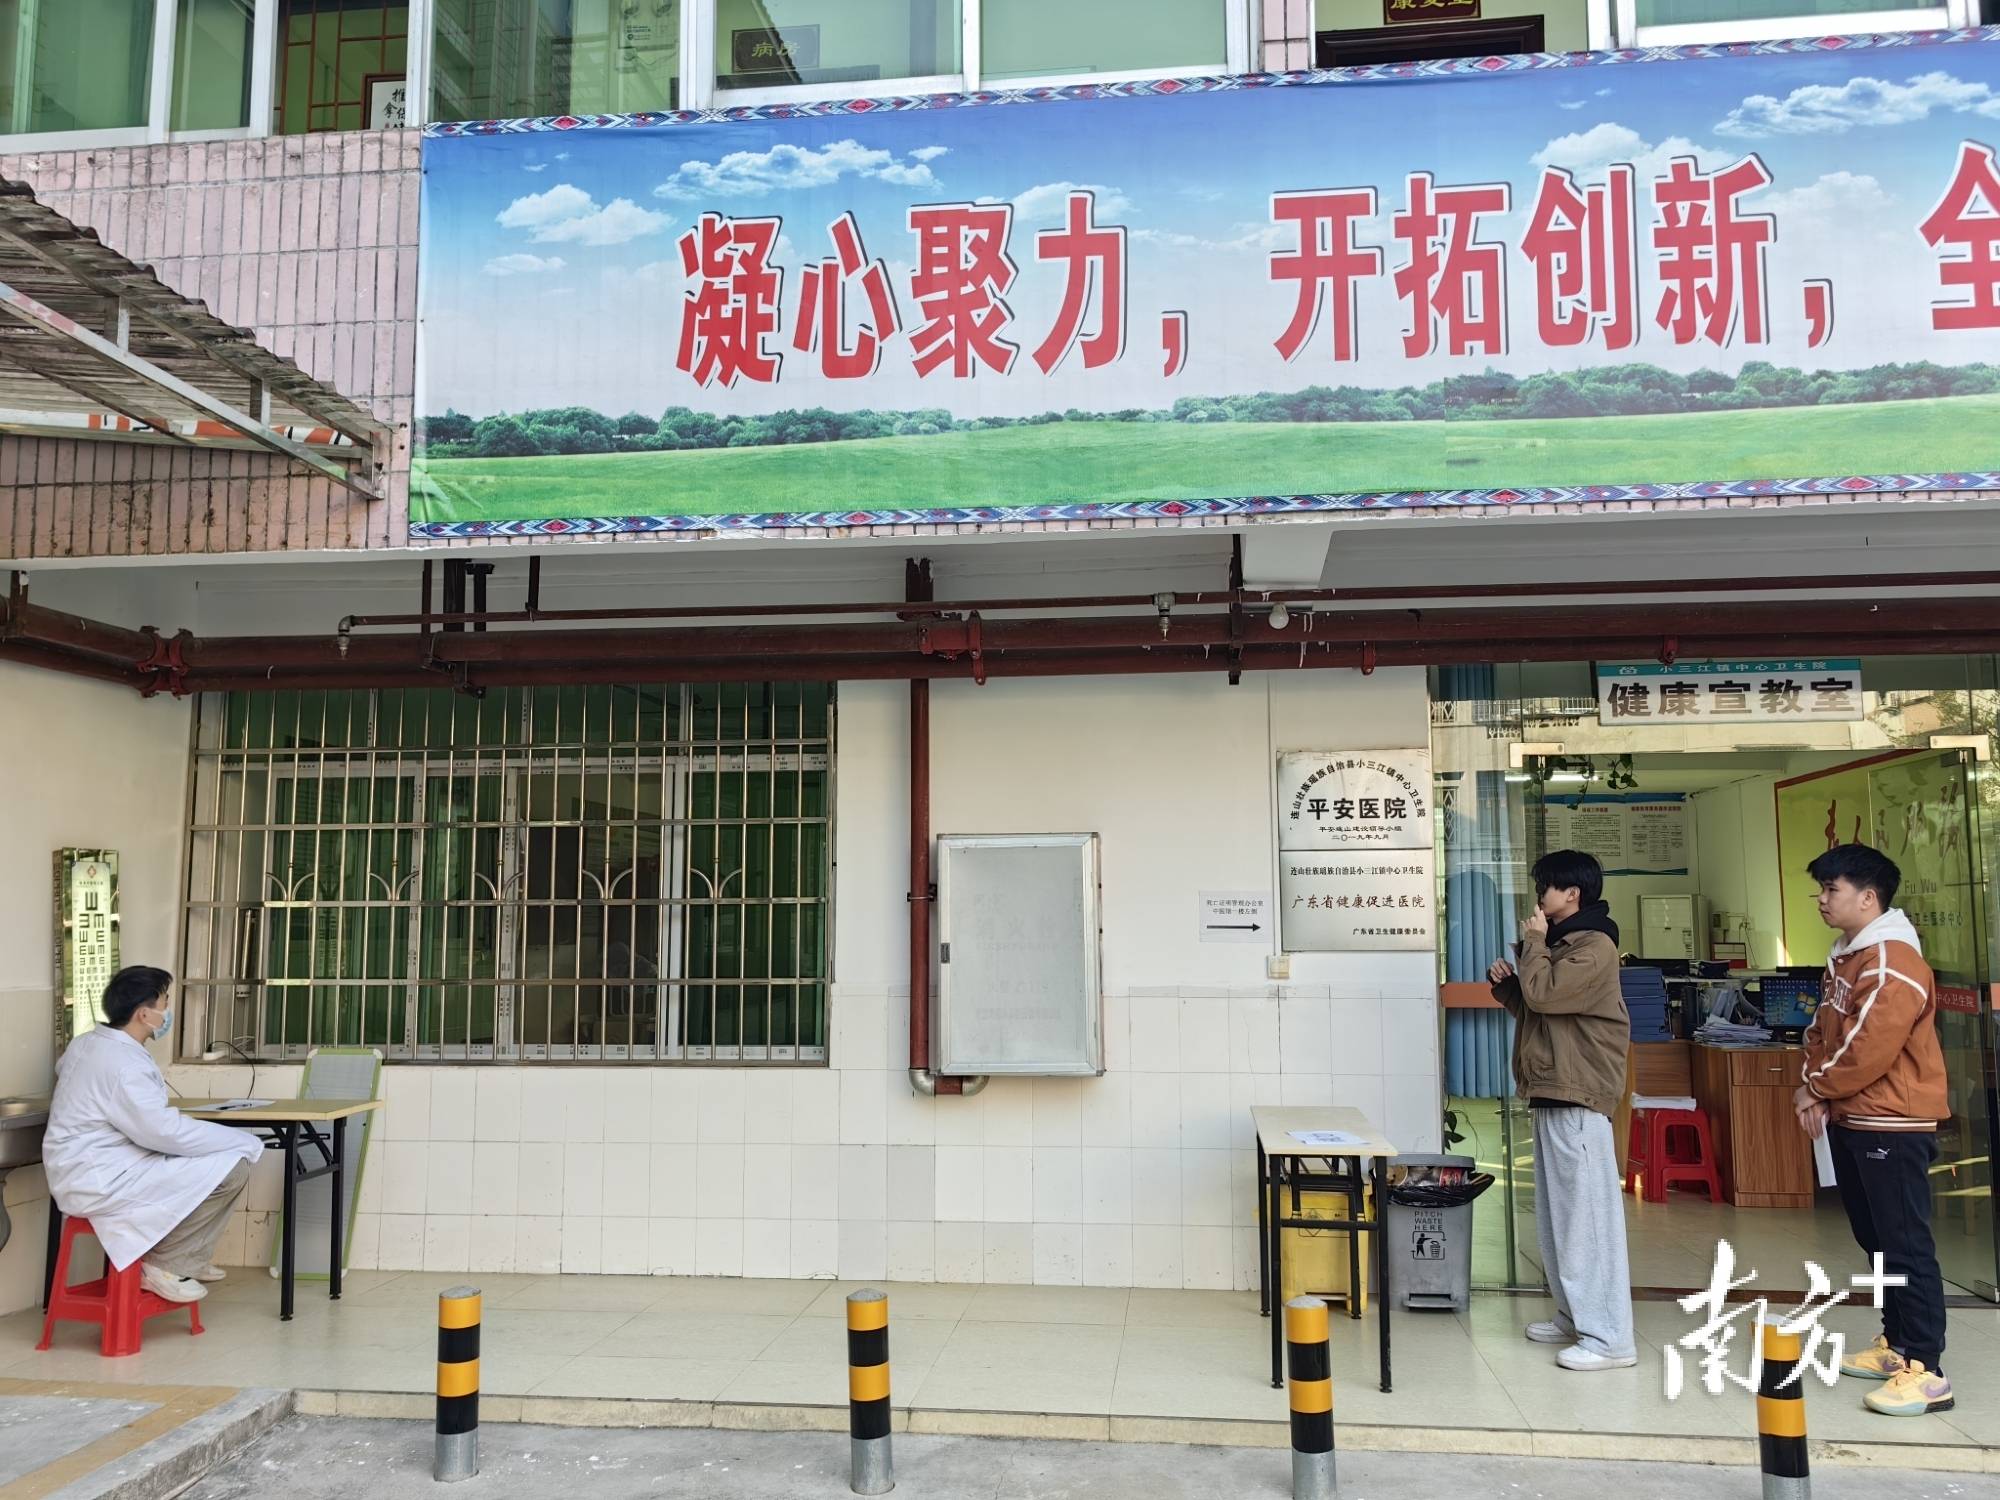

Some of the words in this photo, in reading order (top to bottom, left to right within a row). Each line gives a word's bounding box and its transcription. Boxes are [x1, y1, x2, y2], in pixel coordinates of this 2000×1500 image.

[751, 41, 800, 58] 病房
[1659, 661, 1828, 674] 小三江镇中心卫生院
[1606, 677, 1856, 718] 健康宣教室
[1307, 798, 1407, 821] 平安医院
[1291, 893, 1426, 909] 广东省健康促进医院
